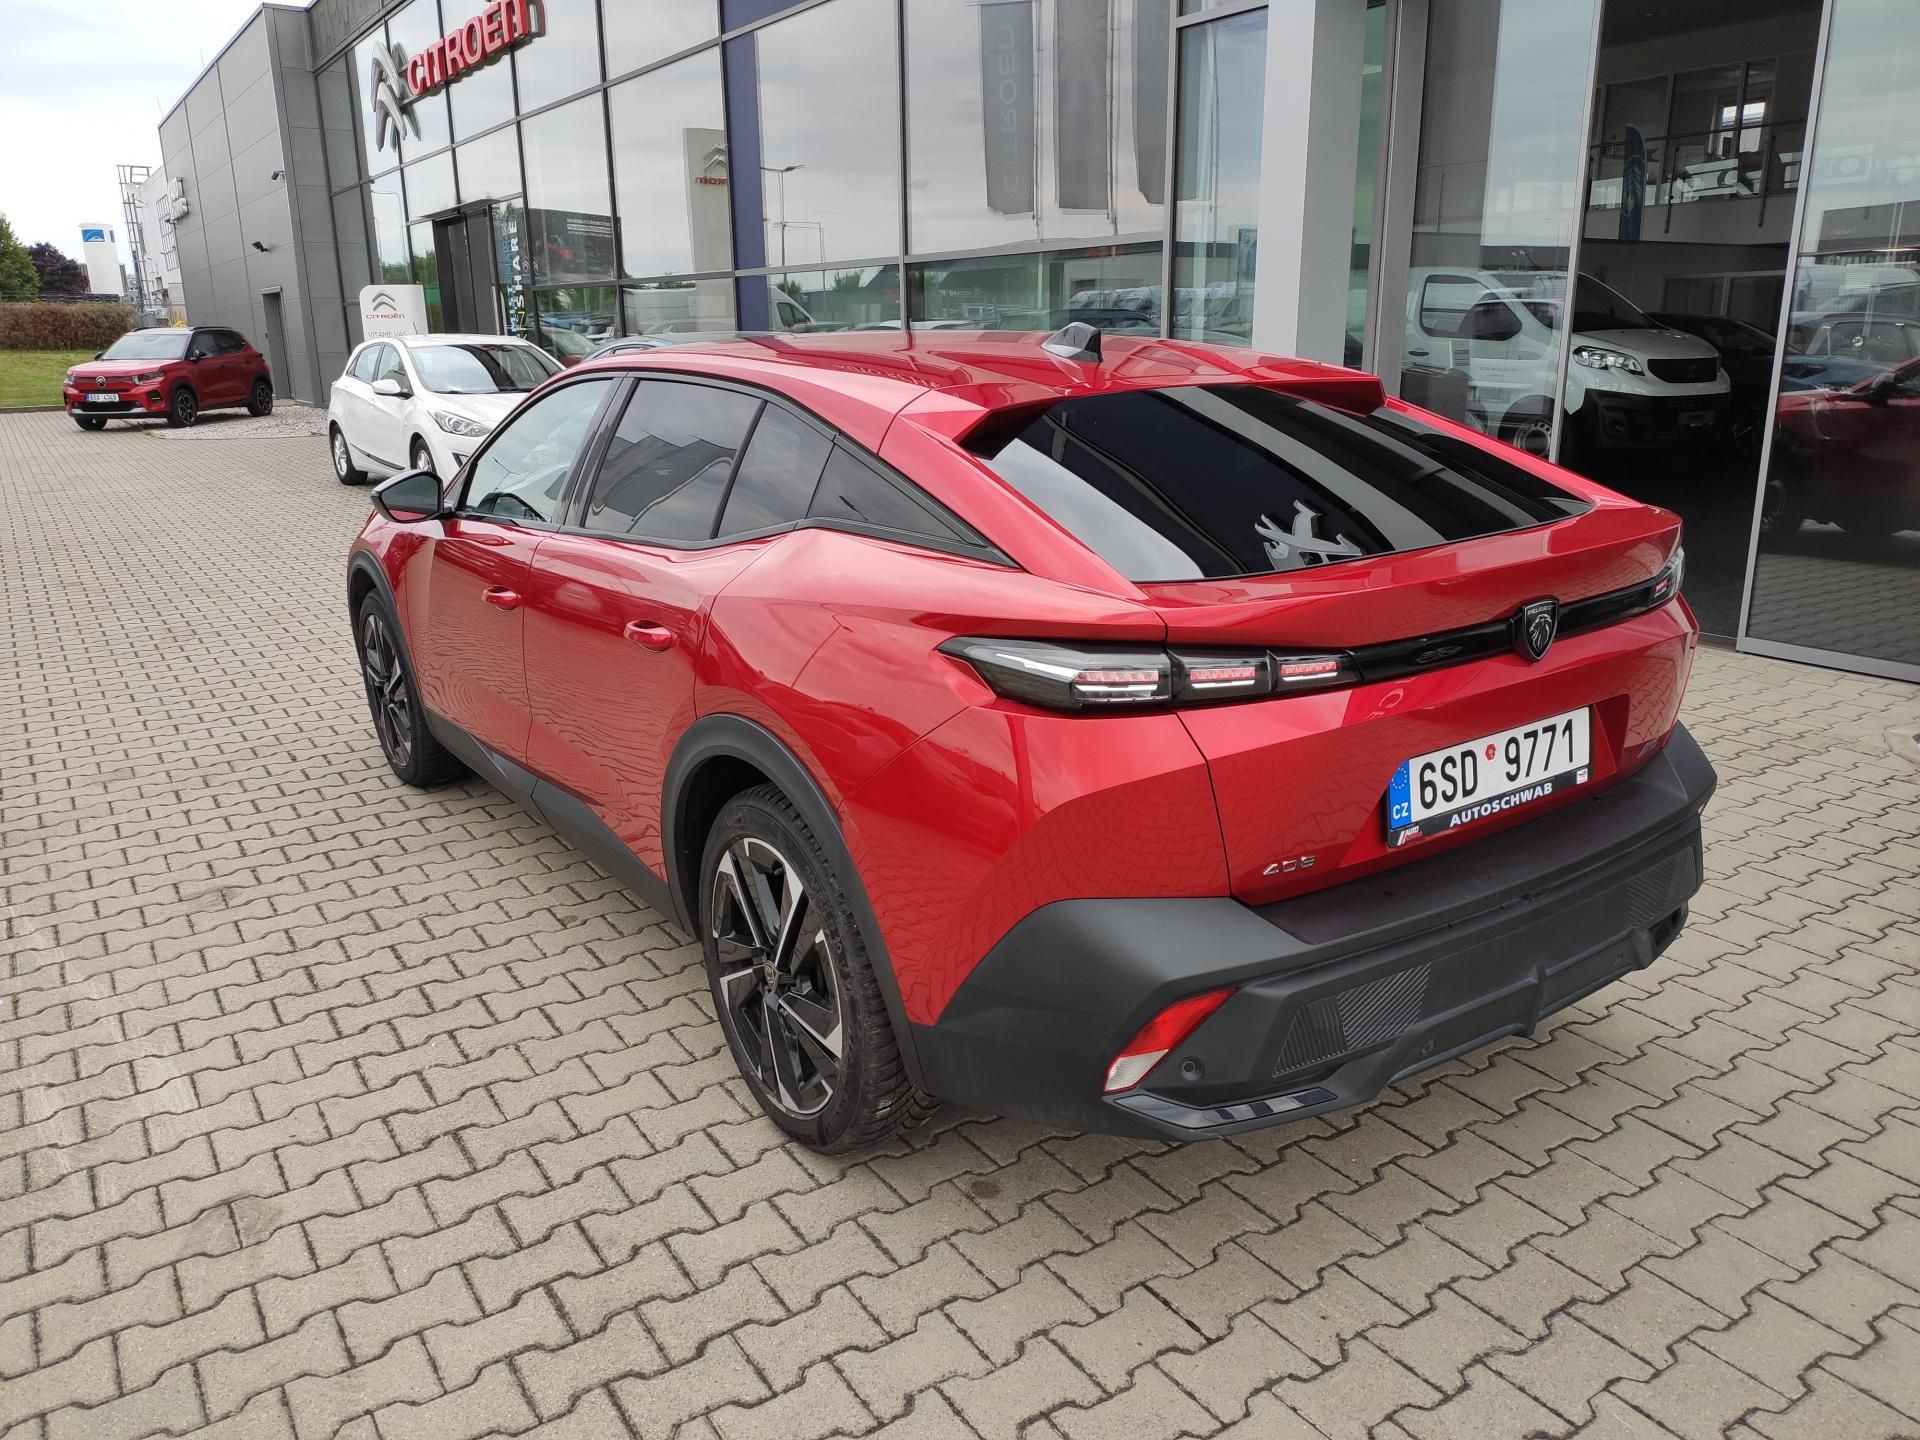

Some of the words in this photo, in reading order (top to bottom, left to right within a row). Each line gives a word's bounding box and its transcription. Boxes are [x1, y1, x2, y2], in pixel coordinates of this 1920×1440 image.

[1419, 749, 1478, 810] 6SD
[1504, 718, 1574, 782] 9771
[1393, 802, 1409, 820] CZ
[1450, 782, 1553, 828] AUTOSCHWAB
